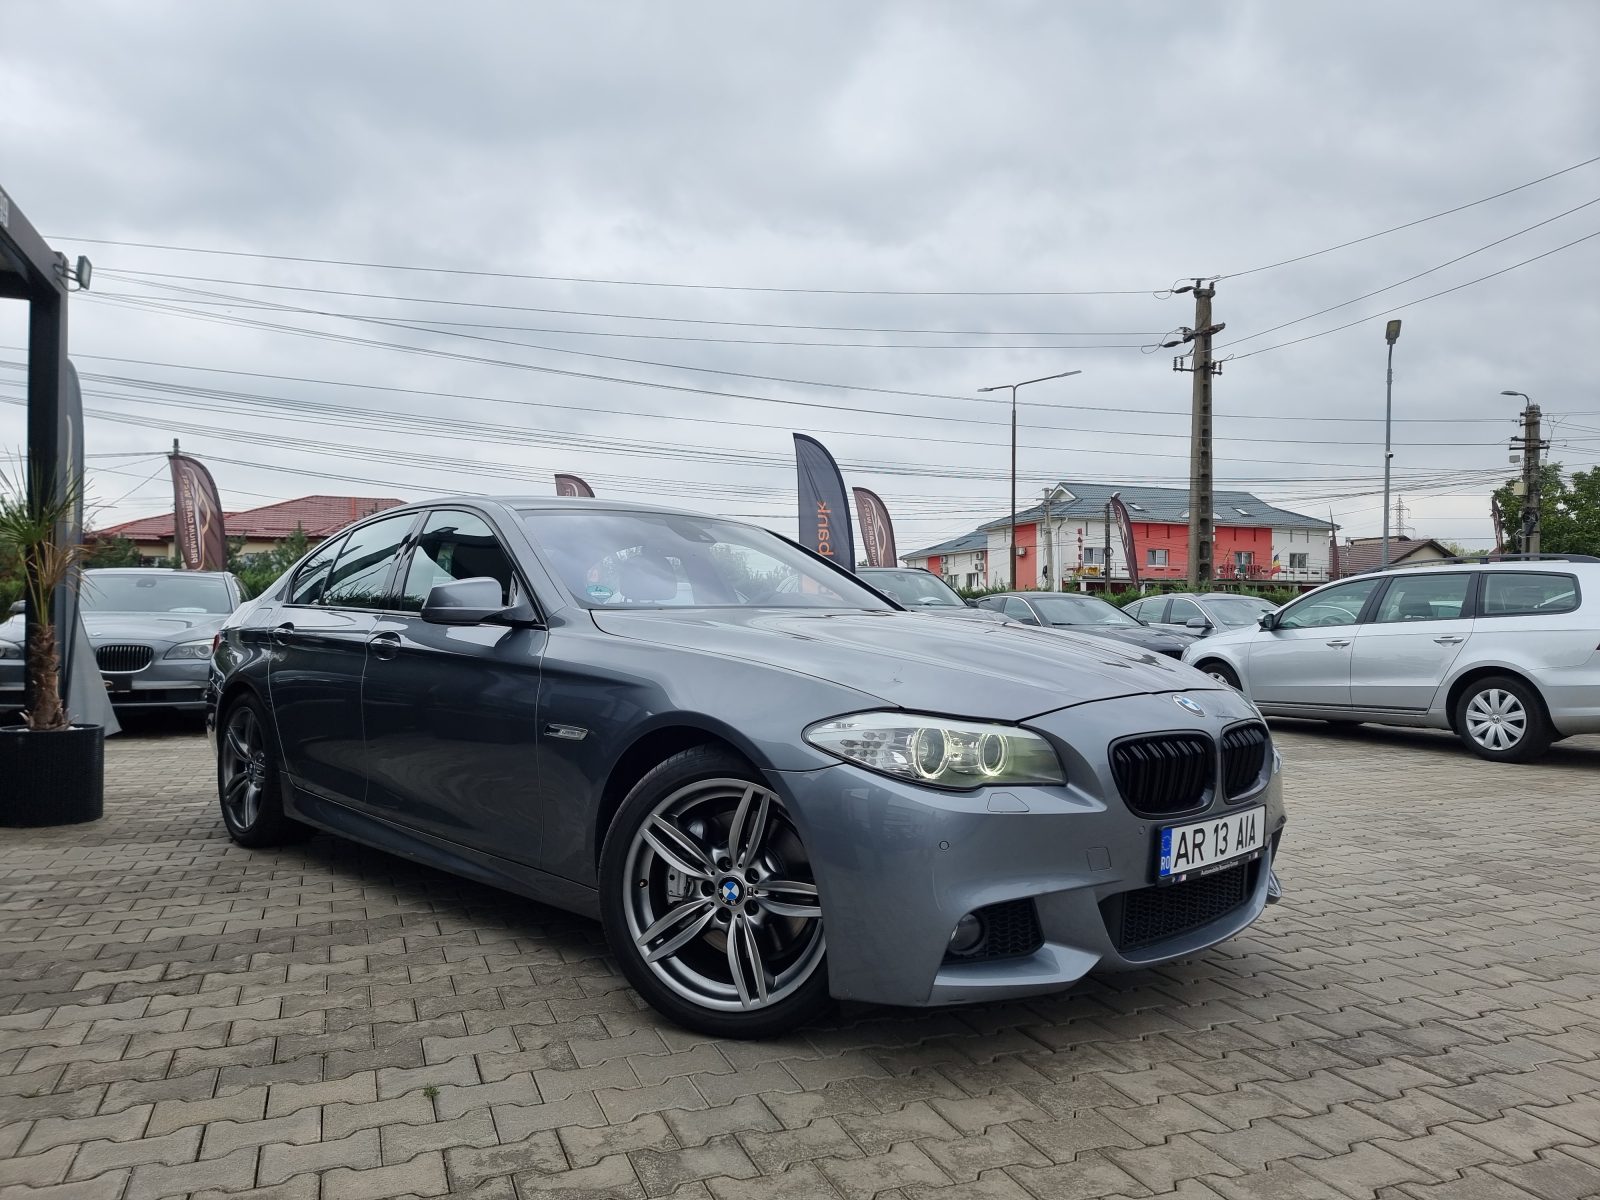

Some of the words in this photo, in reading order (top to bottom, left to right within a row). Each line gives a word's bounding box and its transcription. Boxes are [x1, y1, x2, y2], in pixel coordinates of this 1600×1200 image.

[1173, 827, 1206, 868] AR
[1213, 822, 1229, 857] 13
[1236, 813, 1256, 851] AIA
[1160, 856, 1171, 871] RO
